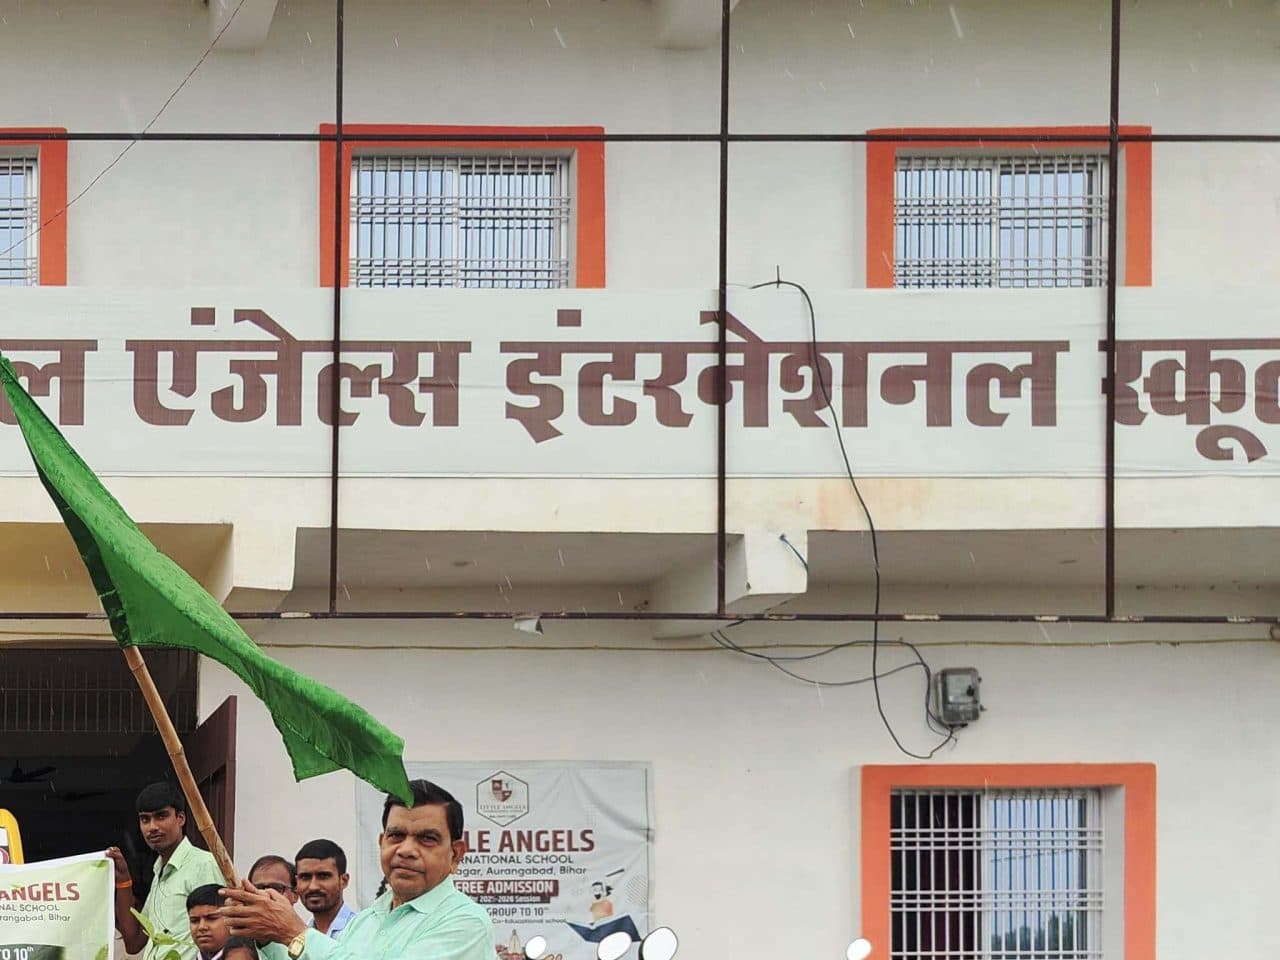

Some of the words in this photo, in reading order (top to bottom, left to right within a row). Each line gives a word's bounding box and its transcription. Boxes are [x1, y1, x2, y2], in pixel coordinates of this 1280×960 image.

[126, 307, 471, 427] एंजेल्स
[500, 309, 1070, 443] इंटरनेशनल
[498, 829, 595, 852] ANGELS
[460, 855, 522, 864] RNATIONAL
[525, 854, 574, 864] SCHOOL
[486, 867, 556, 877] Aurangabad,
[560, 866, 586, 875] Bihar
[455, 881, 484, 893] FREE
[487, 881, 553, 893] ADMISSION
[19, 903, 60, 912] SCHOOL
[520, 907, 531, 916] TO
[48, 913, 71, 922] Bihar
